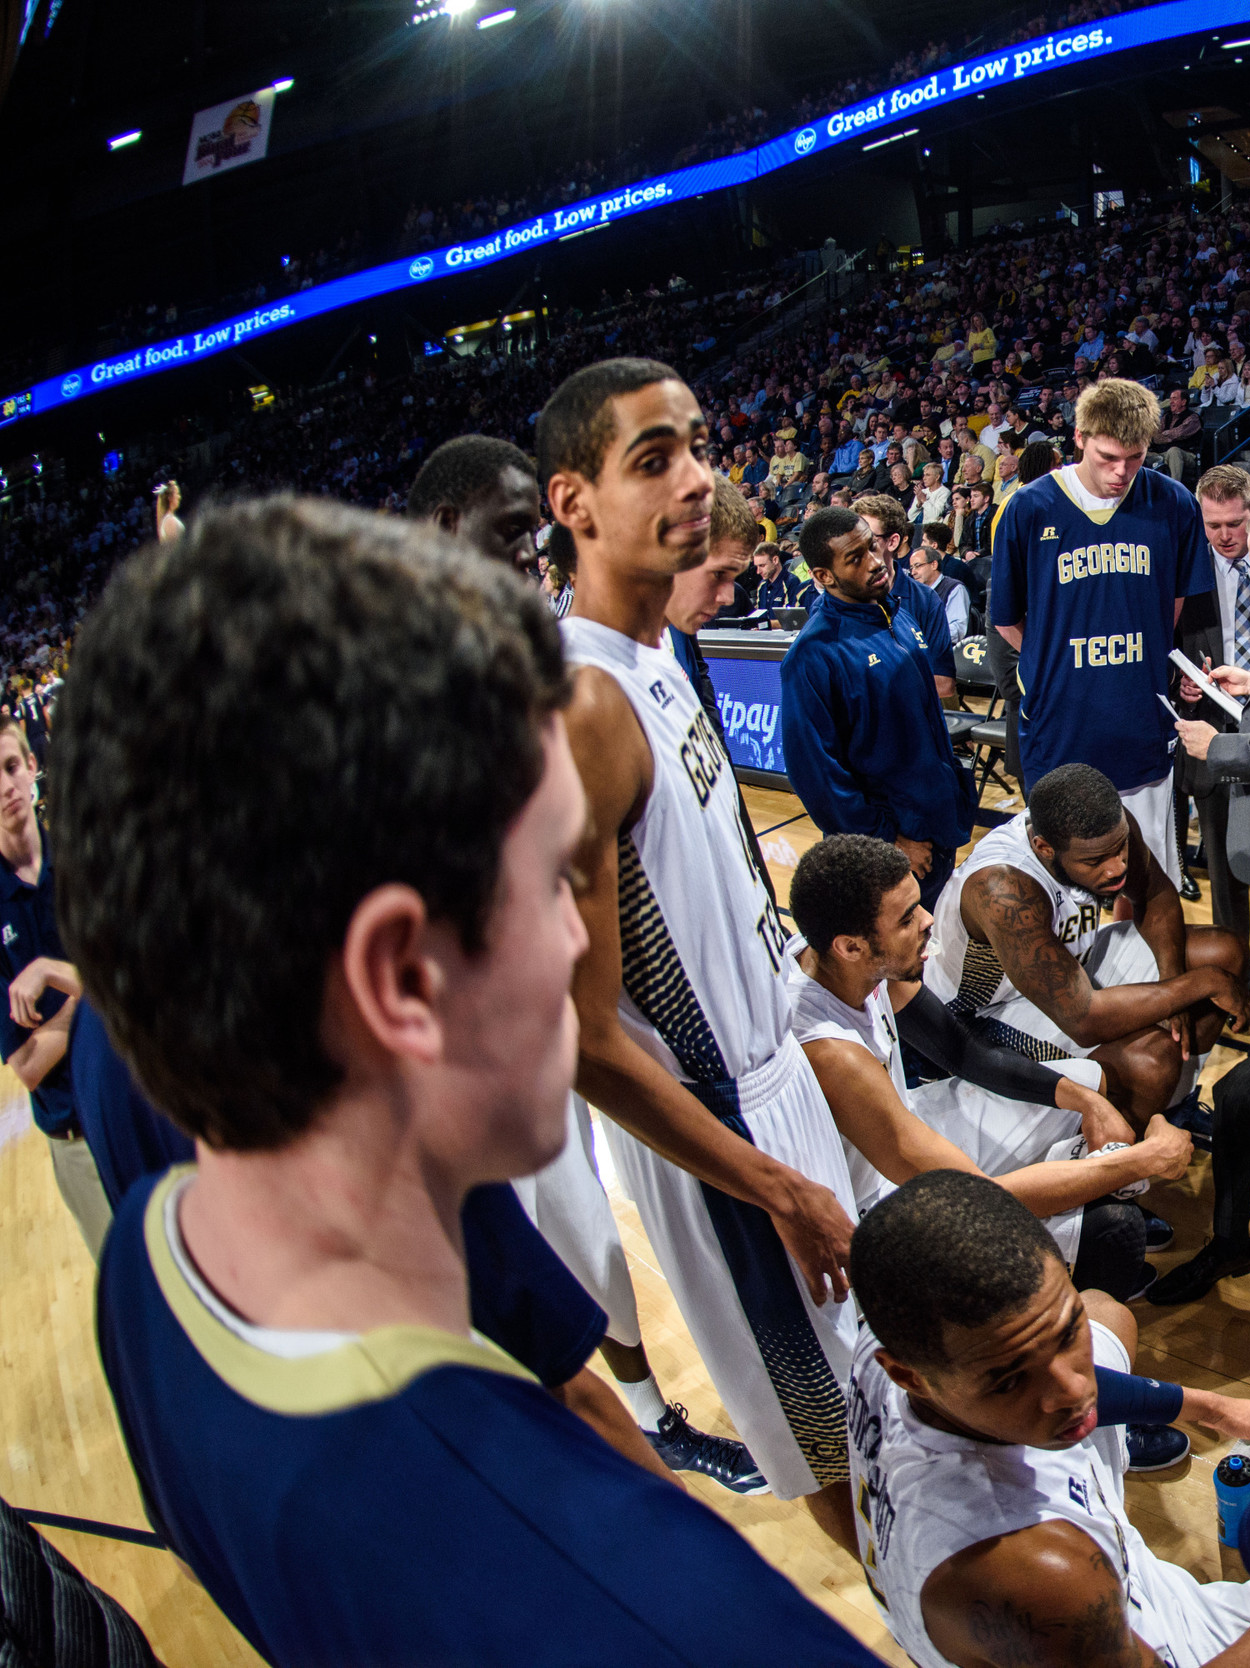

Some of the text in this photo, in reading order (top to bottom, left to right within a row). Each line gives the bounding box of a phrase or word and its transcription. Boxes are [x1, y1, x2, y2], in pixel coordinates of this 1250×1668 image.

[826, 28, 1113, 137] Great food. Low prices.
[445, 182, 673, 267] Great food. Low prices.
[91, 303, 296, 383] Great food. Low prices.
[1057, 542, 1151, 585] GEORGIA
[962, 642, 987, 665] GT
[1069, 631, 1143, 669] TECH
